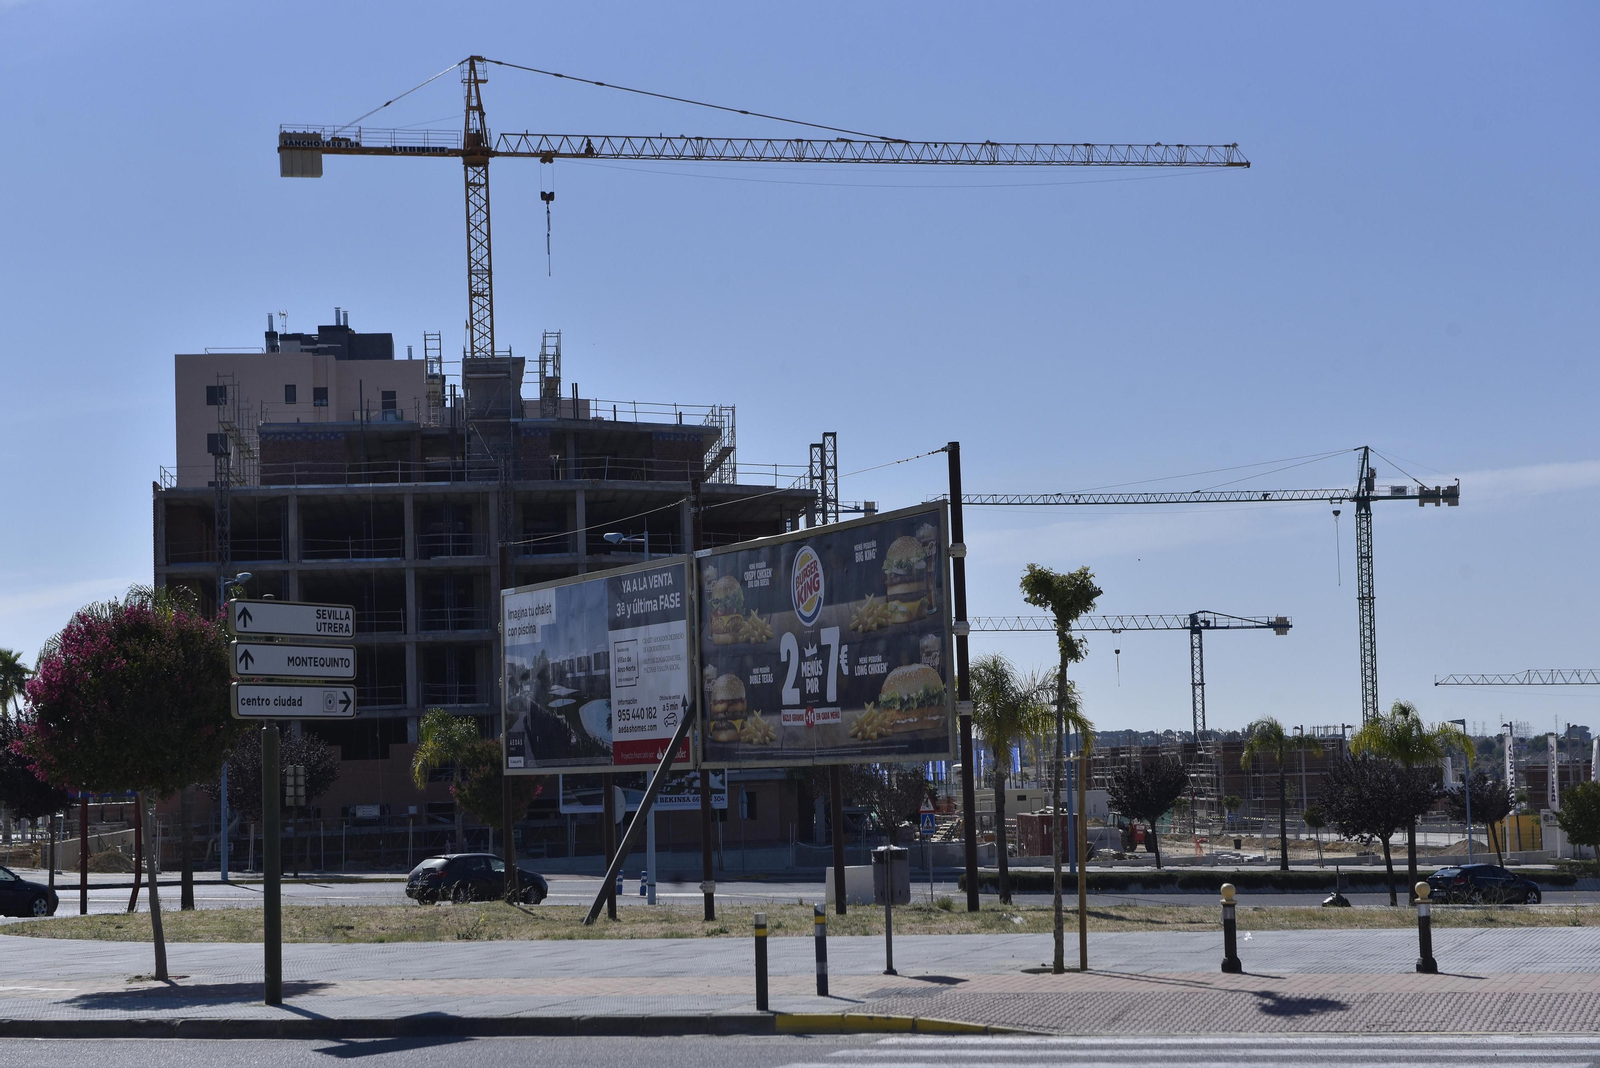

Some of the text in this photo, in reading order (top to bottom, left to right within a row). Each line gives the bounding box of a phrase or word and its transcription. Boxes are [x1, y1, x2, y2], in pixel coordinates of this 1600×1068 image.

[622, 572, 673, 593] YA A LA VENTA
[796, 560, 818, 591] BURGER
[797, 573, 820, 609] KING
[507, 602, 552, 620] Imagina tu chalet
[626, 604, 631, 619] y
[632, 598, 658, 615] última
[659, 592, 680, 611] FASE
[316, 609, 350, 620] SEVILLA
[316, 622, 350, 633] UTRERA
[508, 623, 537, 638] con piscina
[287, 656, 350, 668] MONTEQUINTO
[780, 631, 800, 705] 2
[801, 657, 823, 678] MENÚS
[855, 665, 867, 676] LONG
[806, 678, 819, 694] POR
[241, 696, 303, 706] centro ciudad
[618, 697, 637, 706] Información
[666, 703, 670, 711] 5
[670, 702, 678, 711] min
[617, 706, 657, 721] 955 440 182
[618, 724, 657, 734] aedashomes.com
